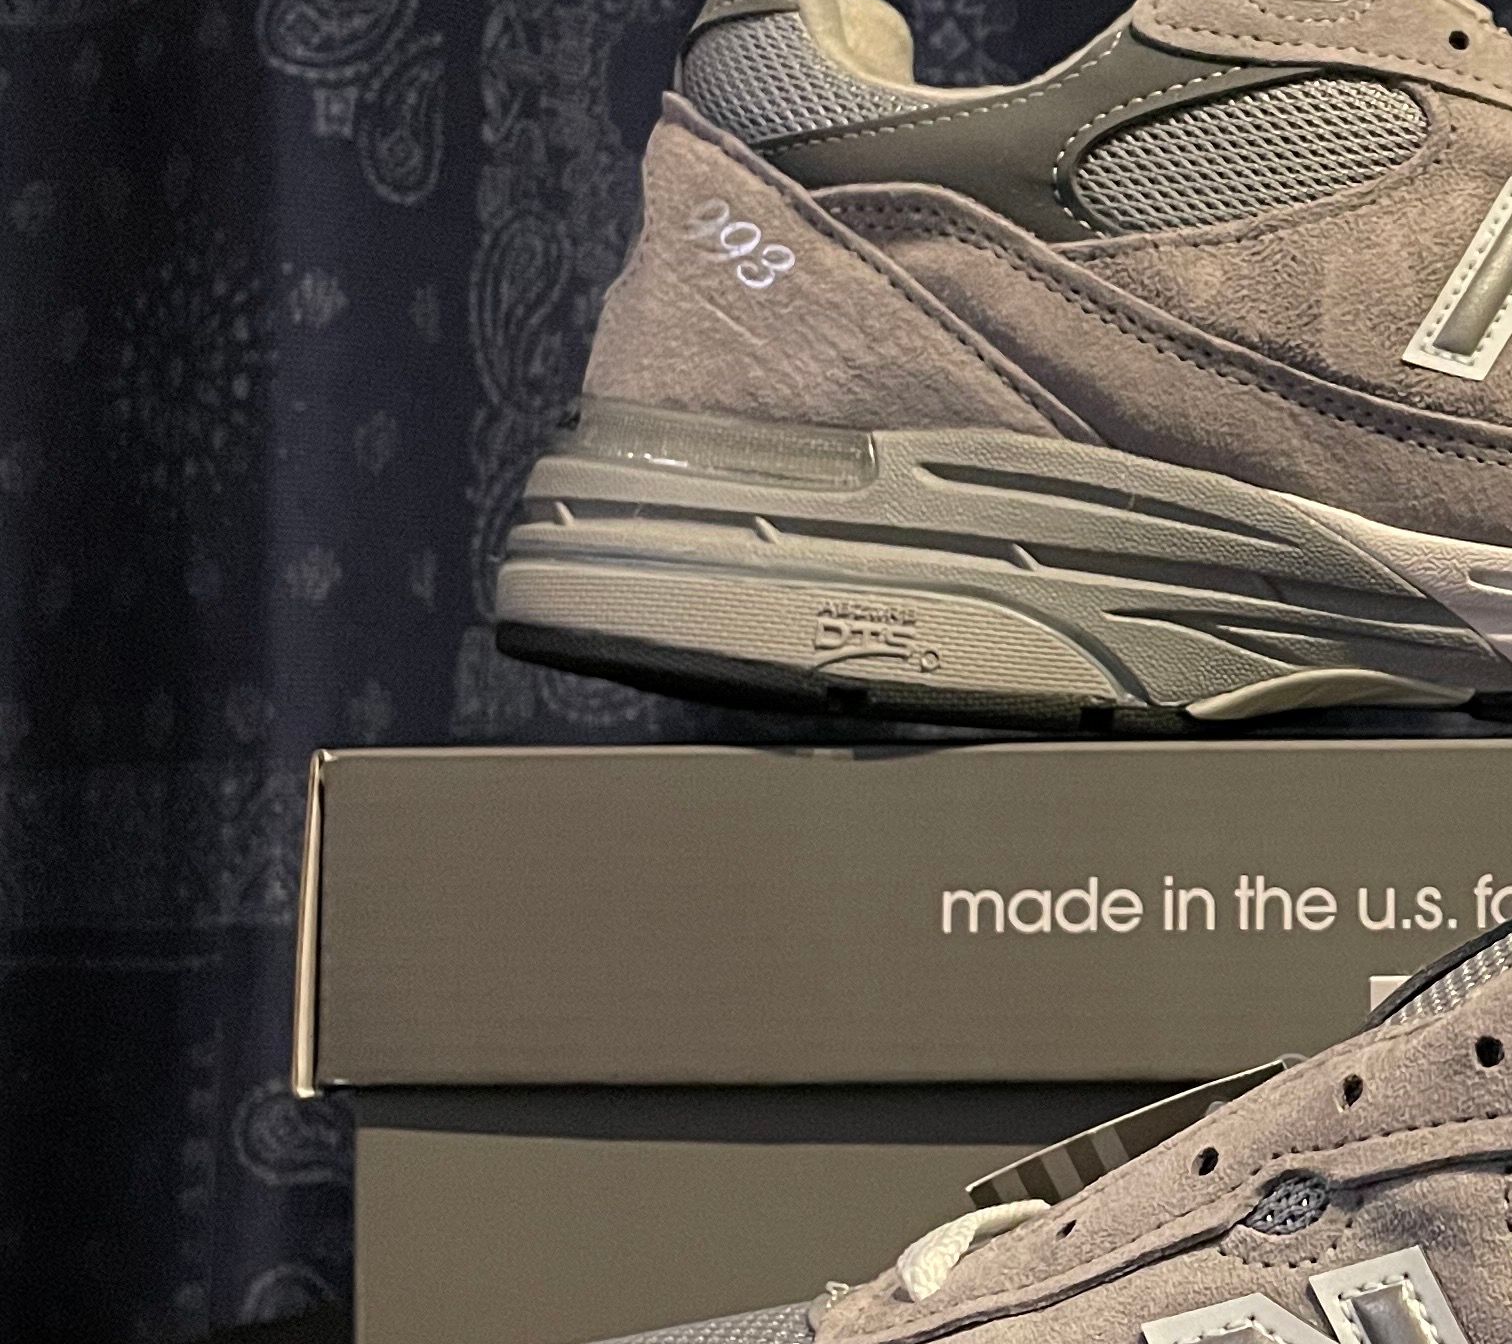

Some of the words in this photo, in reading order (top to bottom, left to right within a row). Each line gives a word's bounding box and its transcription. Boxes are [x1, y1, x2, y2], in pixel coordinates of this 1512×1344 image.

[942, 876, 1144, 934] made
[1163, 875, 1216, 931] in
[1234, 874, 1338, 931] the
[1356, 886, 1458, 931] u.s.
